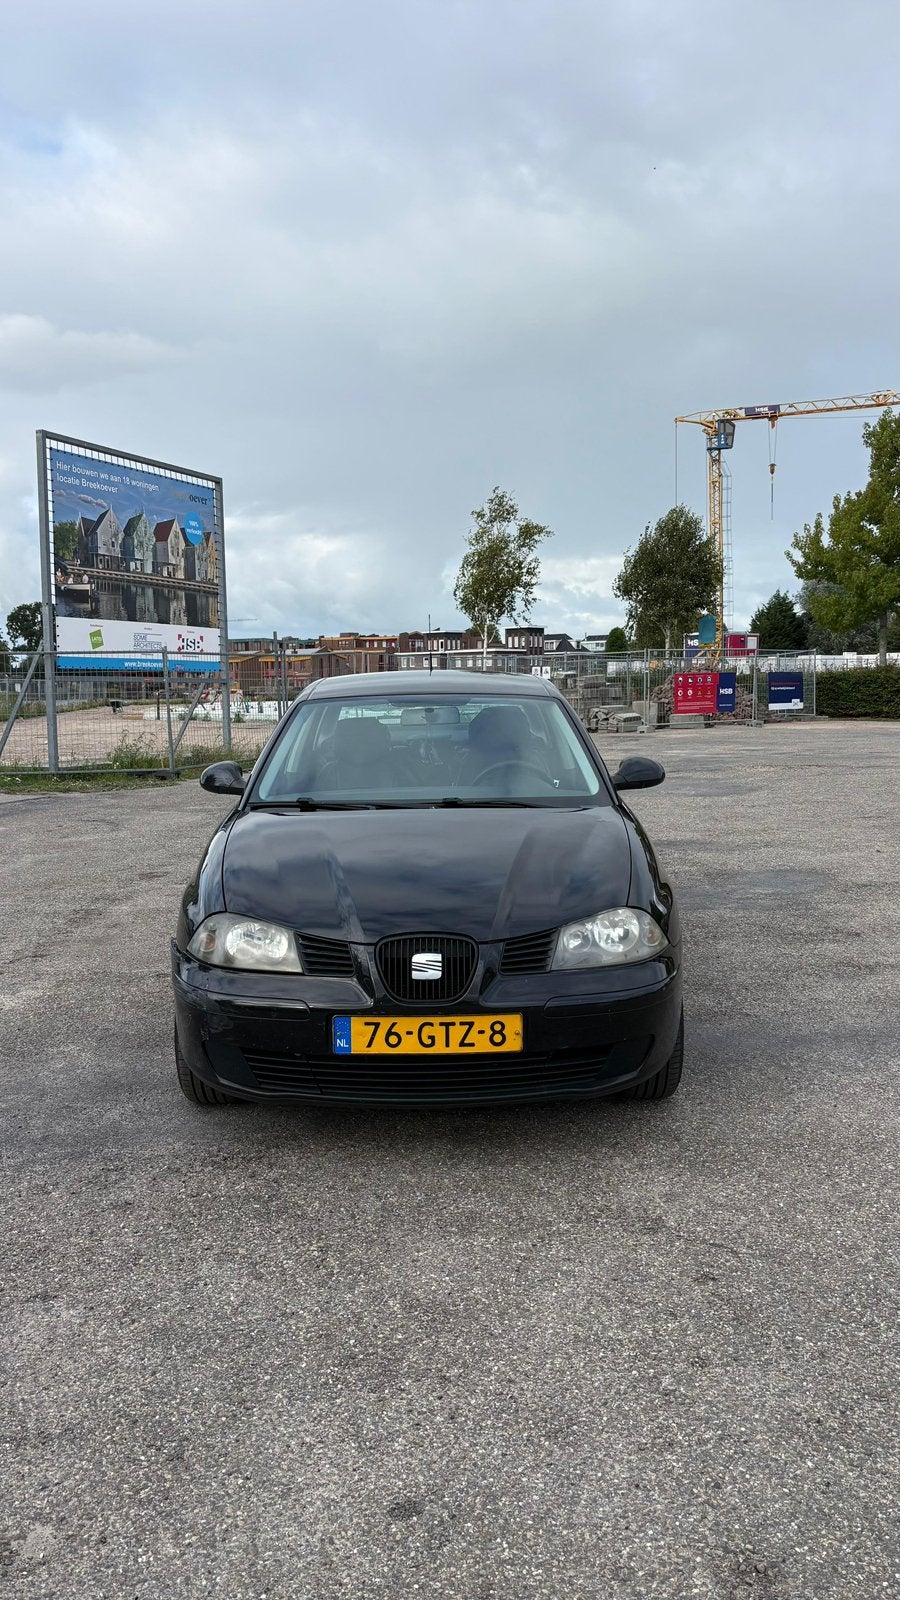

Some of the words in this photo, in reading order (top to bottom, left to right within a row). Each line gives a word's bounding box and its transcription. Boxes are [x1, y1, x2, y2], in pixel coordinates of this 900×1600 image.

[56, 461, 71, 472] Hier
[72, 464, 99, 478] bouwen
[110, 474, 122, 483] aan
[130, 479, 159, 492] woningen
[57, 473, 80, 486] locatie
[81, 479, 118, 493] Breekoever
[133, 642, 163, 650] ARCHITECTS
[687, 639, 699, 647] HS
[719, 687, 733, 695] HSB
[336, 1038, 349, 1048] NL
[363, 1020, 507, 1049] 76-GTZ-8
